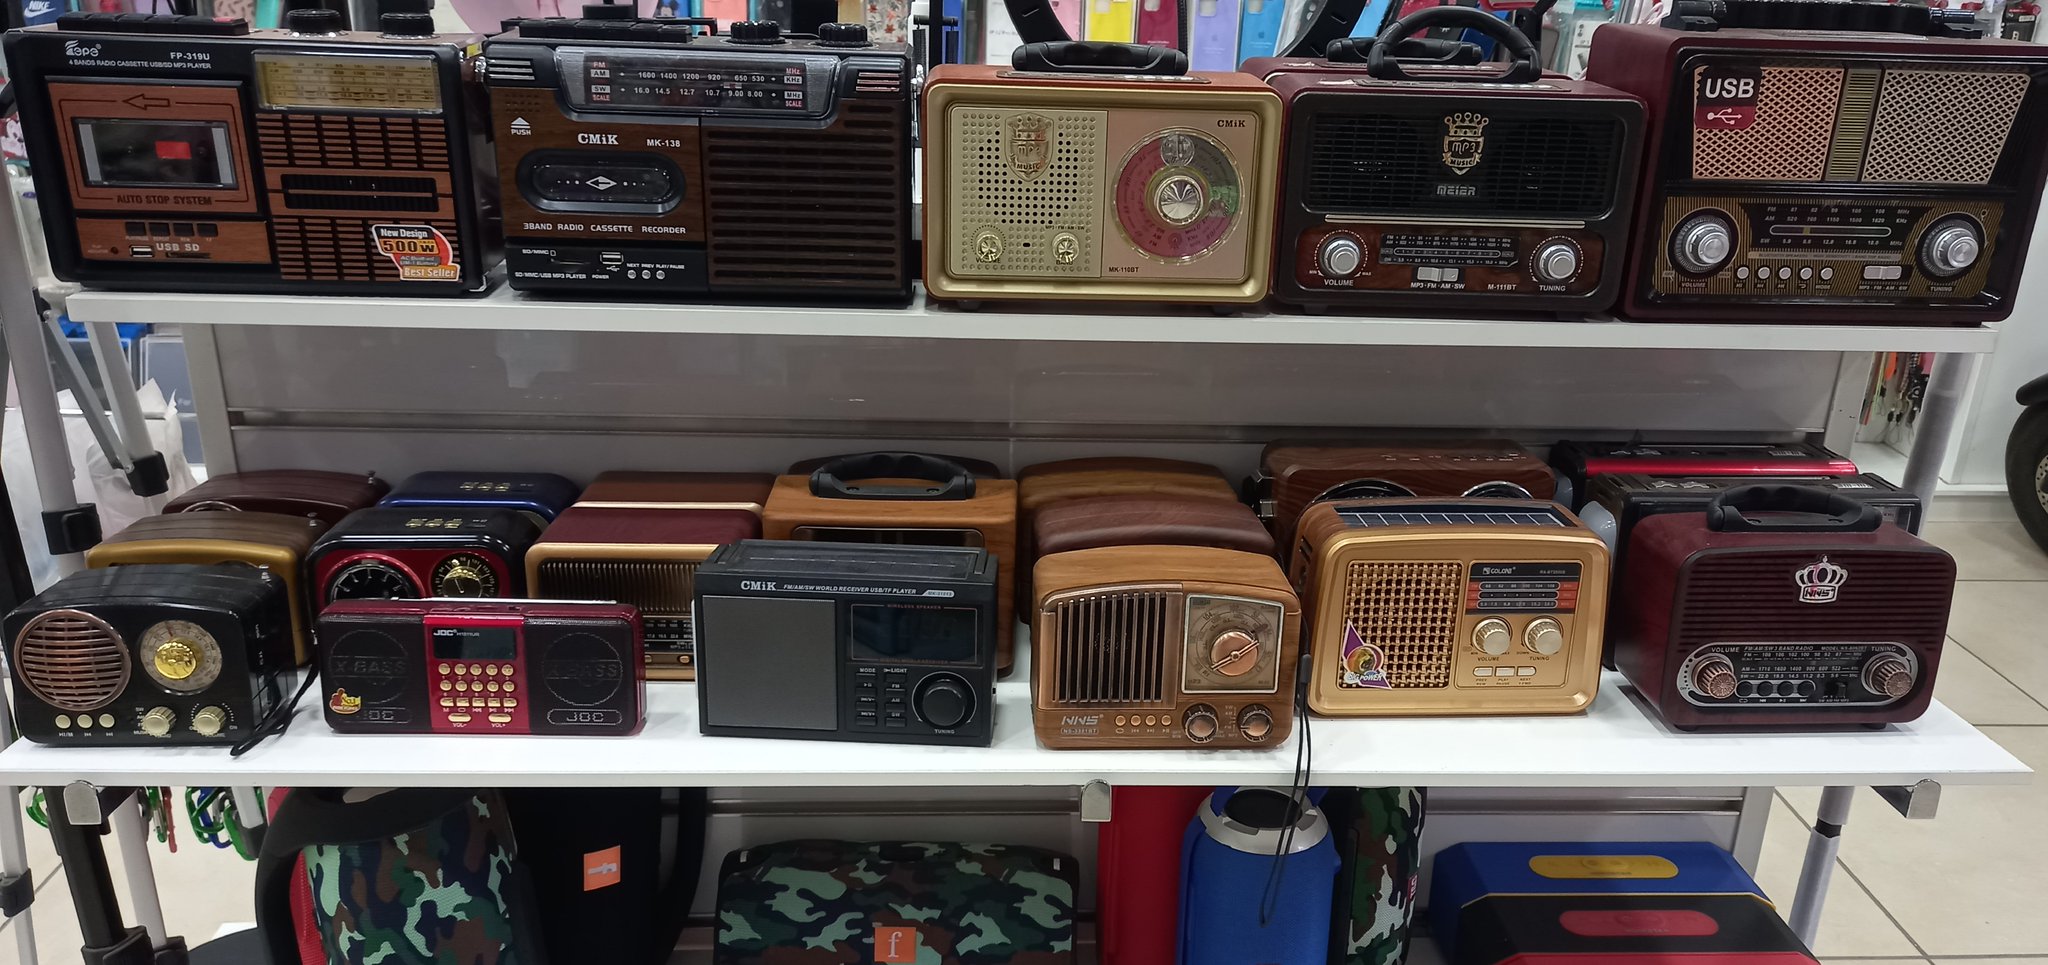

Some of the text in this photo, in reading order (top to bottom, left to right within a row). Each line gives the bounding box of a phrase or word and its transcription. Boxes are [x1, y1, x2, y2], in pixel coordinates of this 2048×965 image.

[29, 0, 50, 10] NIKE
[170, 52, 210, 60] FP-319U
[679, 88, 695, 96] 12.7
[1705, 78, 1755, 99] USB
[577, 133, 619, 145] CMiK
[646, 139, 681, 148] MK-138
[117, 194, 213, 205] AUTO STOP SYSTEM
[523, 222, 686, 234] 3BAND RADIO CASSETTE RECORDER
[380, 229, 428, 239] New Design
[156, 243, 200, 252] USB SD
[404, 267, 455, 277] Best Seller
[741, 581, 777, 591] CMiK
[839, 585, 869, 593] RECEIVER
[566, 712, 604, 722] JOC
[1062, 715, 1099, 725] NNS
[888, 931, 902, 958] f
